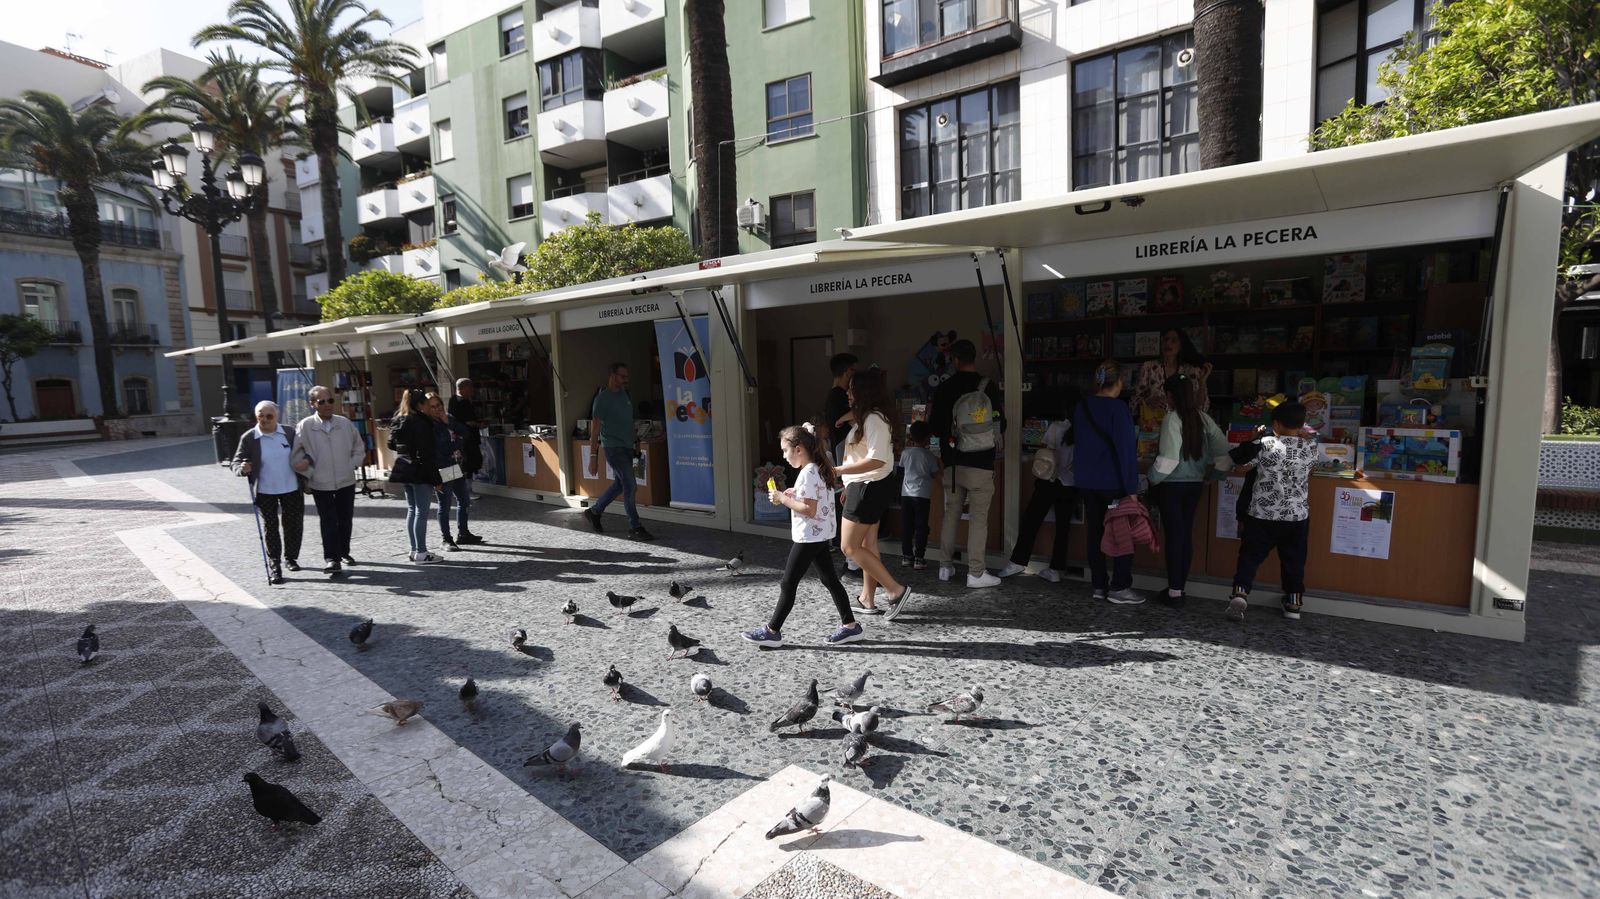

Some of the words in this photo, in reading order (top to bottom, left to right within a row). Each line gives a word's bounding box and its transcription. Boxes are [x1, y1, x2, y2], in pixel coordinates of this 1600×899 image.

[1135, 236, 1208, 258] LIBRERÍA
[1215, 235, 1236, 250] LA
[1243, 226, 1317, 247] PECERA
[810, 277, 852, 293] LIBRERÍA
[855, 278, 868, 289] LA
[871, 273, 912, 287] PECERA
[626, 306, 633, 315] LA
[635, 303, 659, 314] PECERA
[1340, 490, 1350, 501] 35
